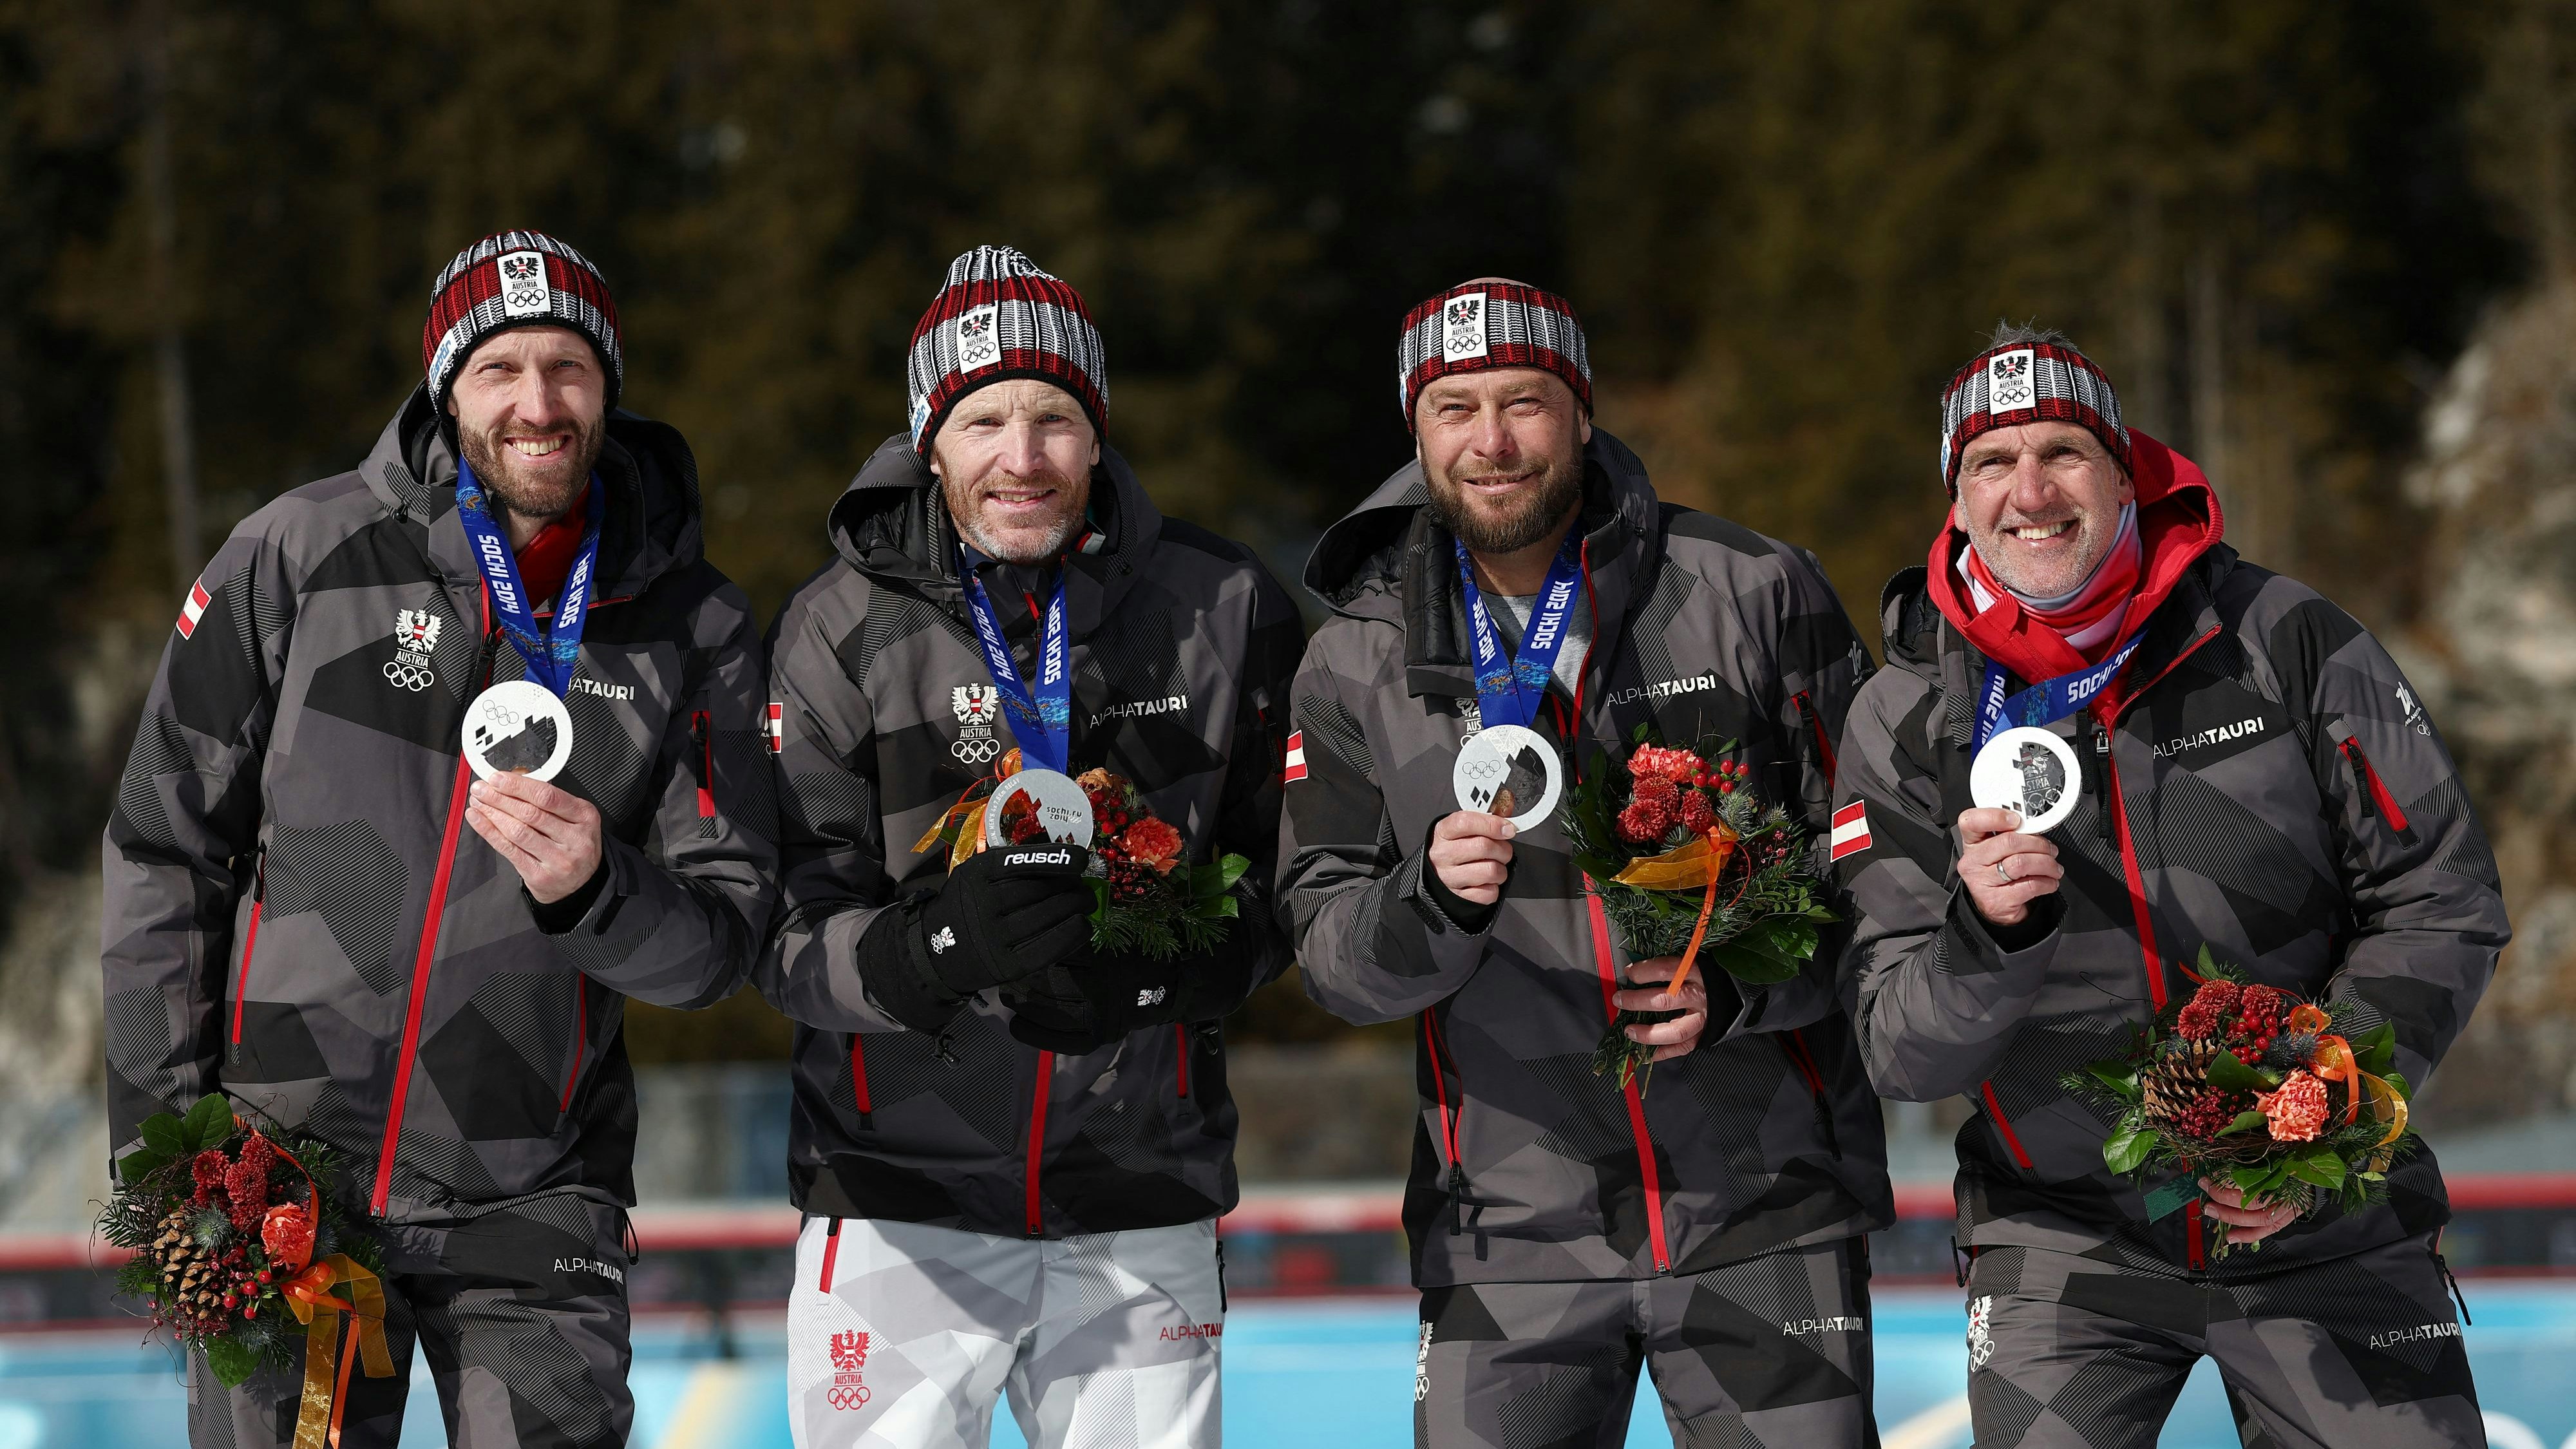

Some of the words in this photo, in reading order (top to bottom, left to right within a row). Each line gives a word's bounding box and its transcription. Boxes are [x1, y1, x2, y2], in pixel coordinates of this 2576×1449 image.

[513, 281, 538, 290] AUSTRIA
[966, 336, 989, 348] AUSTRIA
[1452, 326, 1475, 336] AUSTRIA
[1999, 379, 2023, 390] AUSTRIA
[477, 534, 509, 578] SOCHI
[571, 552, 591, 591] 2014
[491, 580, 520, 614] 2014
[558, 587, 585, 629] SOCHI
[1546, 580, 1575, 610] 2014
[1047, 596, 1062, 641] 2014
[1531, 612, 1563, 649] SOCHI
[395, 650, 428, 668] AUSTRIA
[1044, 634, 1062, 686] SOCHI
[1478, 628, 1497, 667] 2014
[987, 643, 1015, 681] 2014
[568, 677, 634, 700] ATAURI
[1607, 674, 1716, 707] ALPHATAURI
[2068, 663, 2113, 705] SOCHI
[960, 727, 992, 739] AUSTRIA
[2153, 716, 2264, 759] ALPHATAURI
[1050, 813, 1068, 823] 2014
[1003, 849, 1071, 866] reusch
[554, 1258, 623, 1285] ALPHATAURI
[1159, 1323, 1222, 1341] ALPHATAU
[1783, 1316, 1863, 1336] ALPHATAURI
[834, 1374, 863, 1385] AUSTRIA
